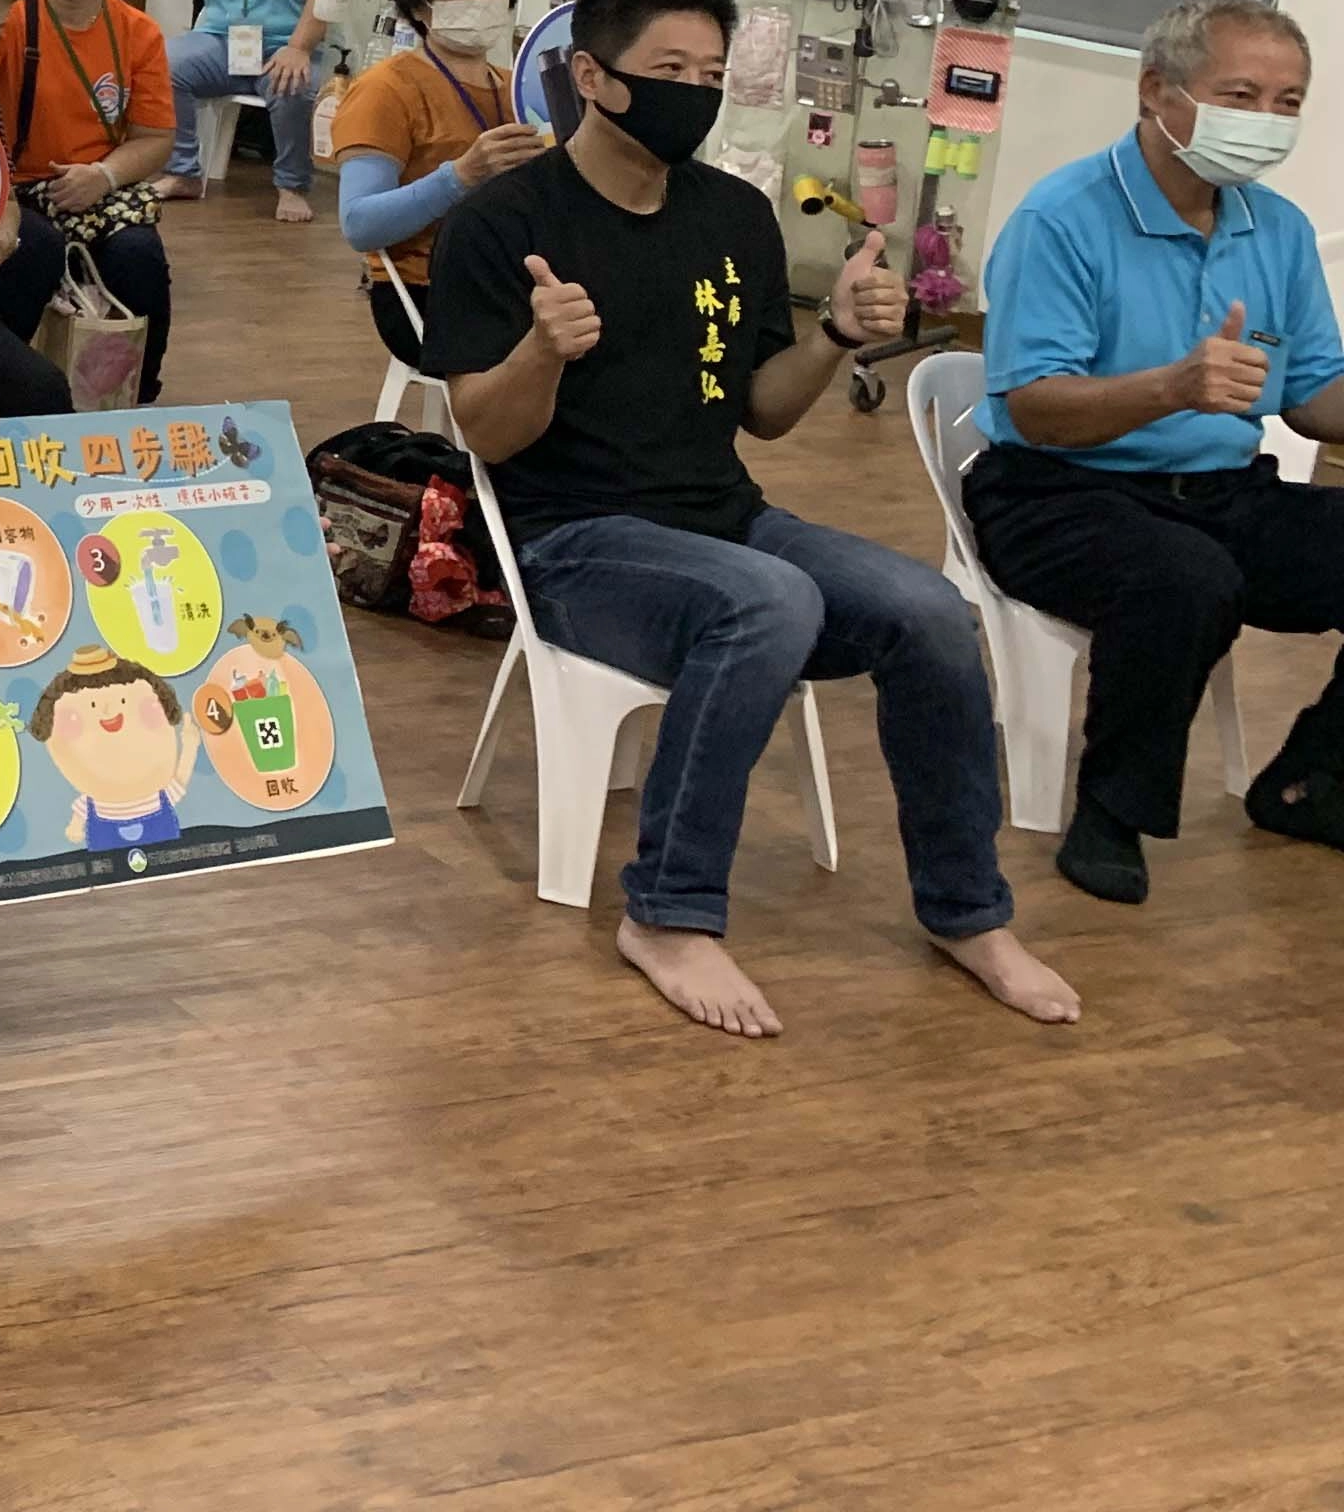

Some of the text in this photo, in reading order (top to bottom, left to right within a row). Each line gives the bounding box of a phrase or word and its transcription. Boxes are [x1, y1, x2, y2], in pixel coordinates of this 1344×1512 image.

[93, 548, 106, 573] 3
[206, 698, 220, 721] 4
[266, 777, 299, 798] 回收
